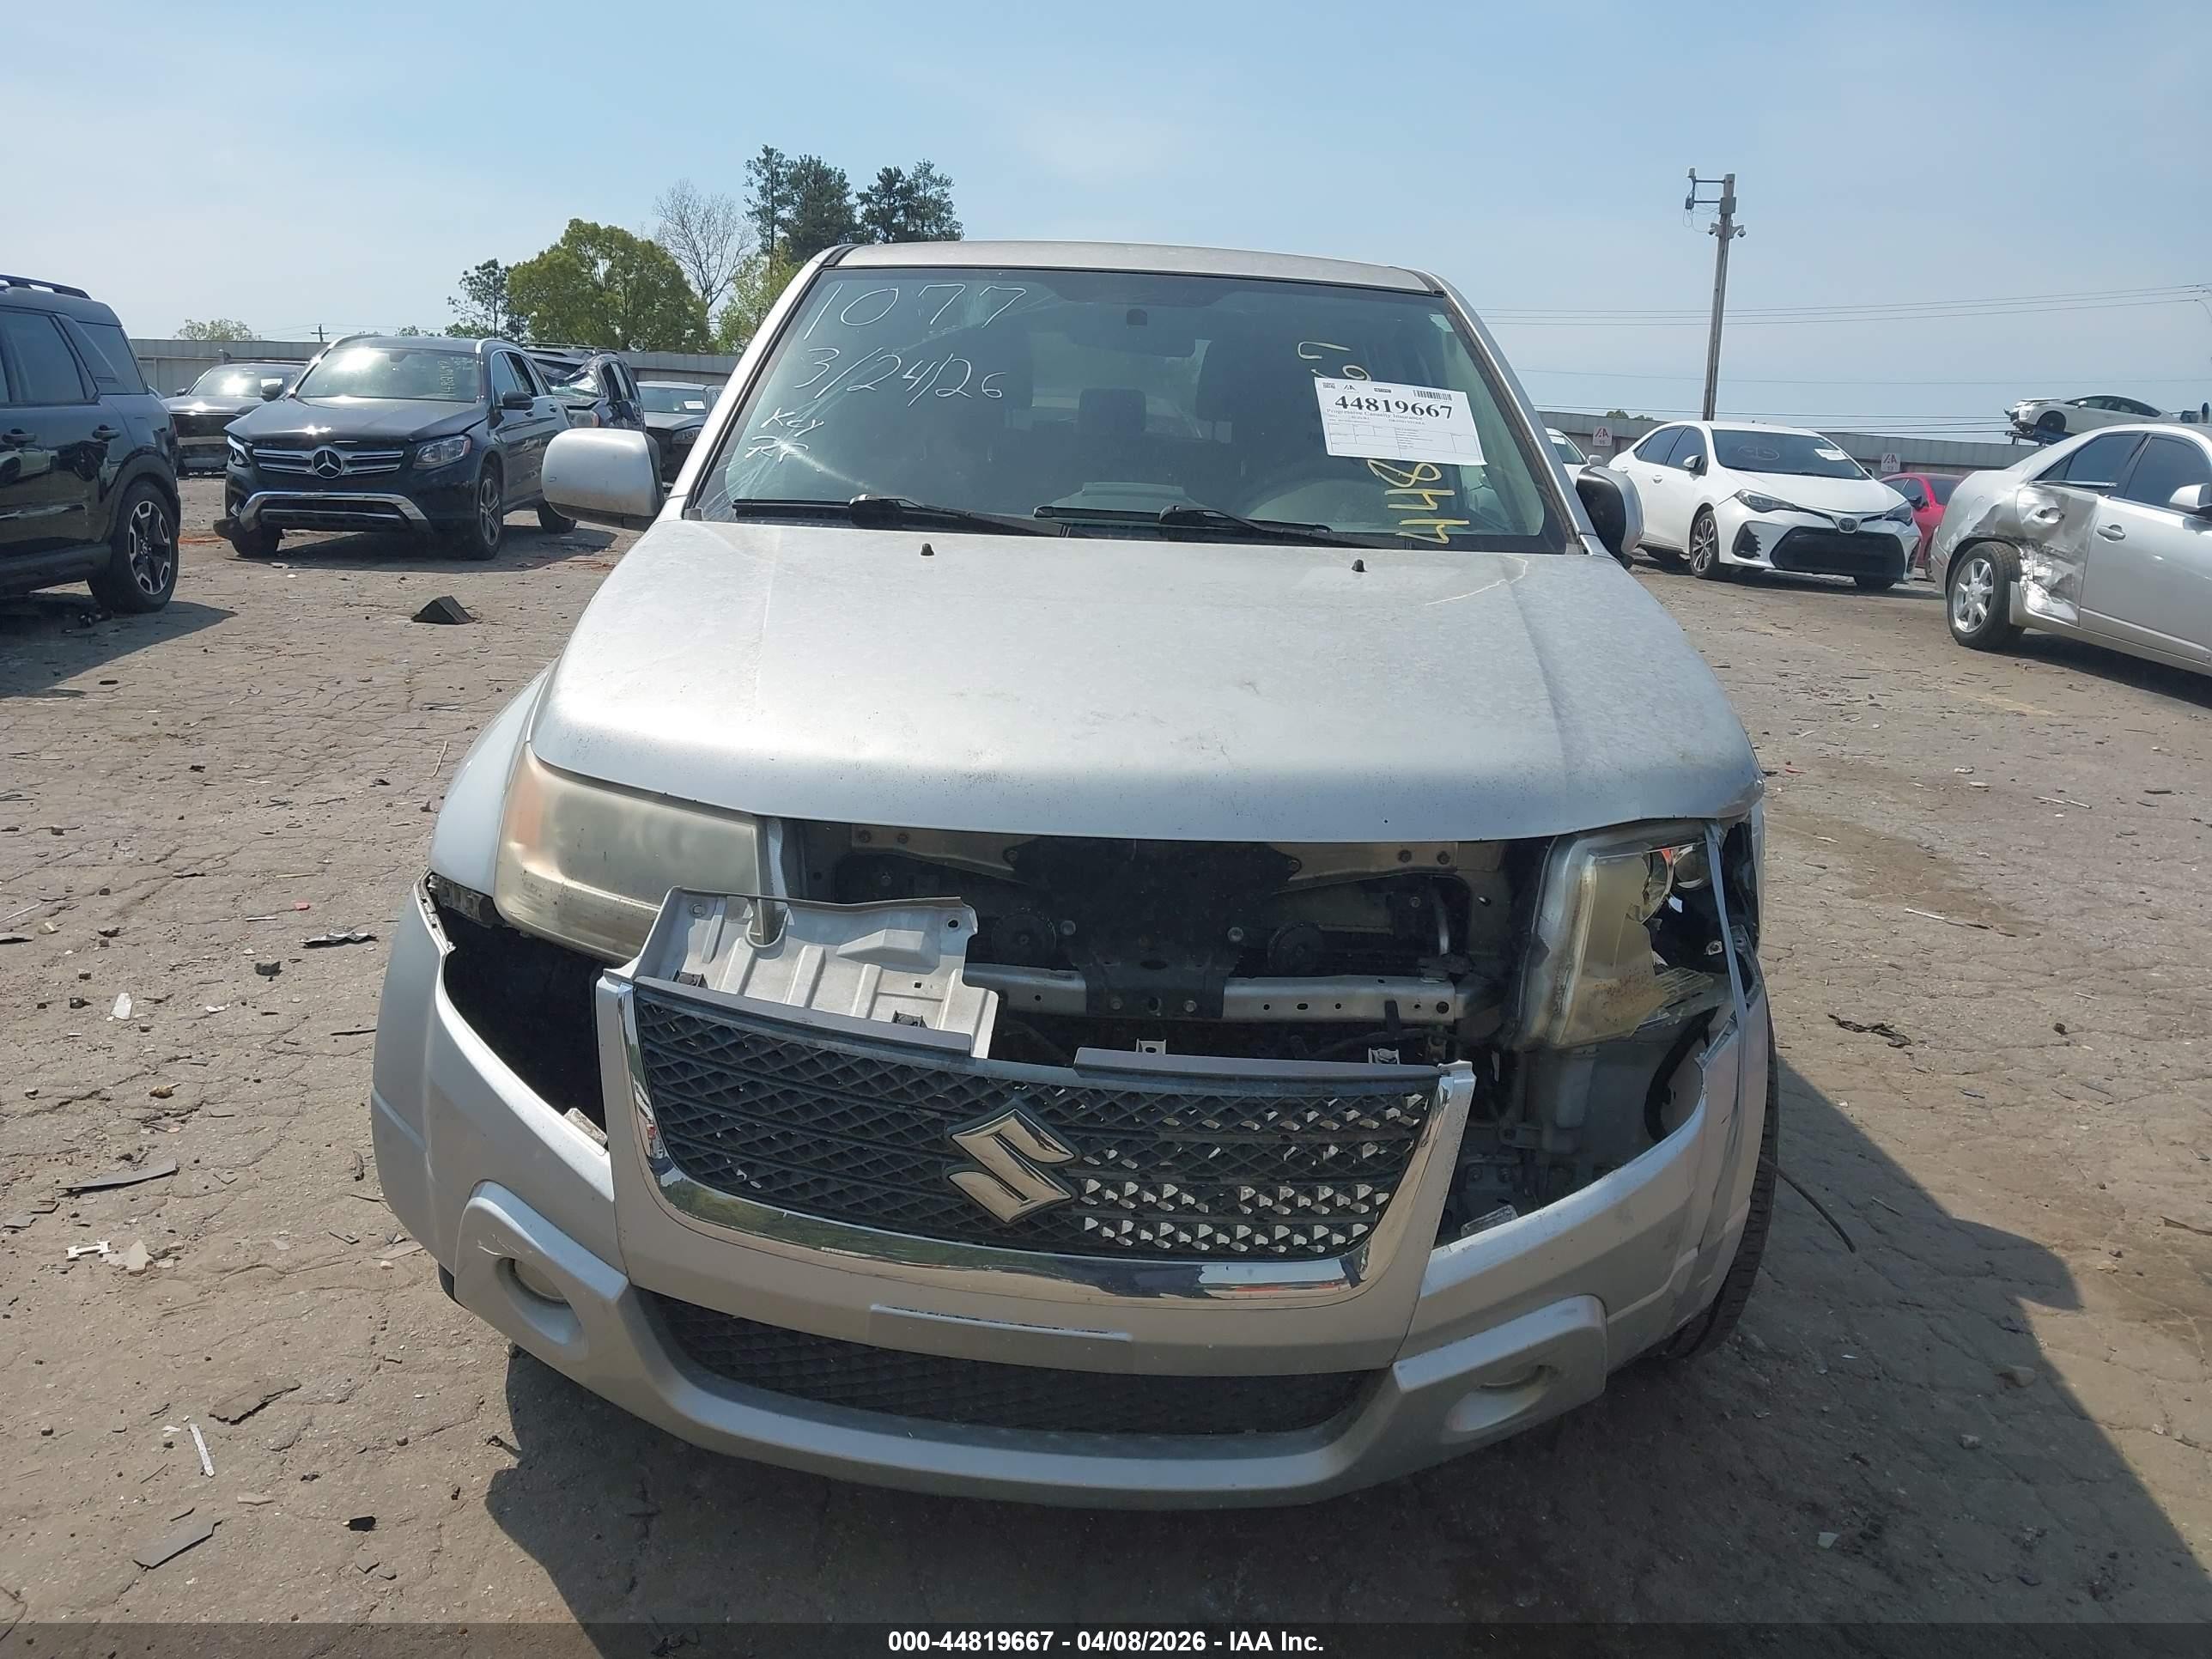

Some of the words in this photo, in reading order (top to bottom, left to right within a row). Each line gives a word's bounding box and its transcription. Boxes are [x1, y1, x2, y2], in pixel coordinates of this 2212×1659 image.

[804, 283, 1027, 340] 1077
[793, 347, 1006, 408] 3/24/26
[1334, 395, 1452, 420] 44819667
